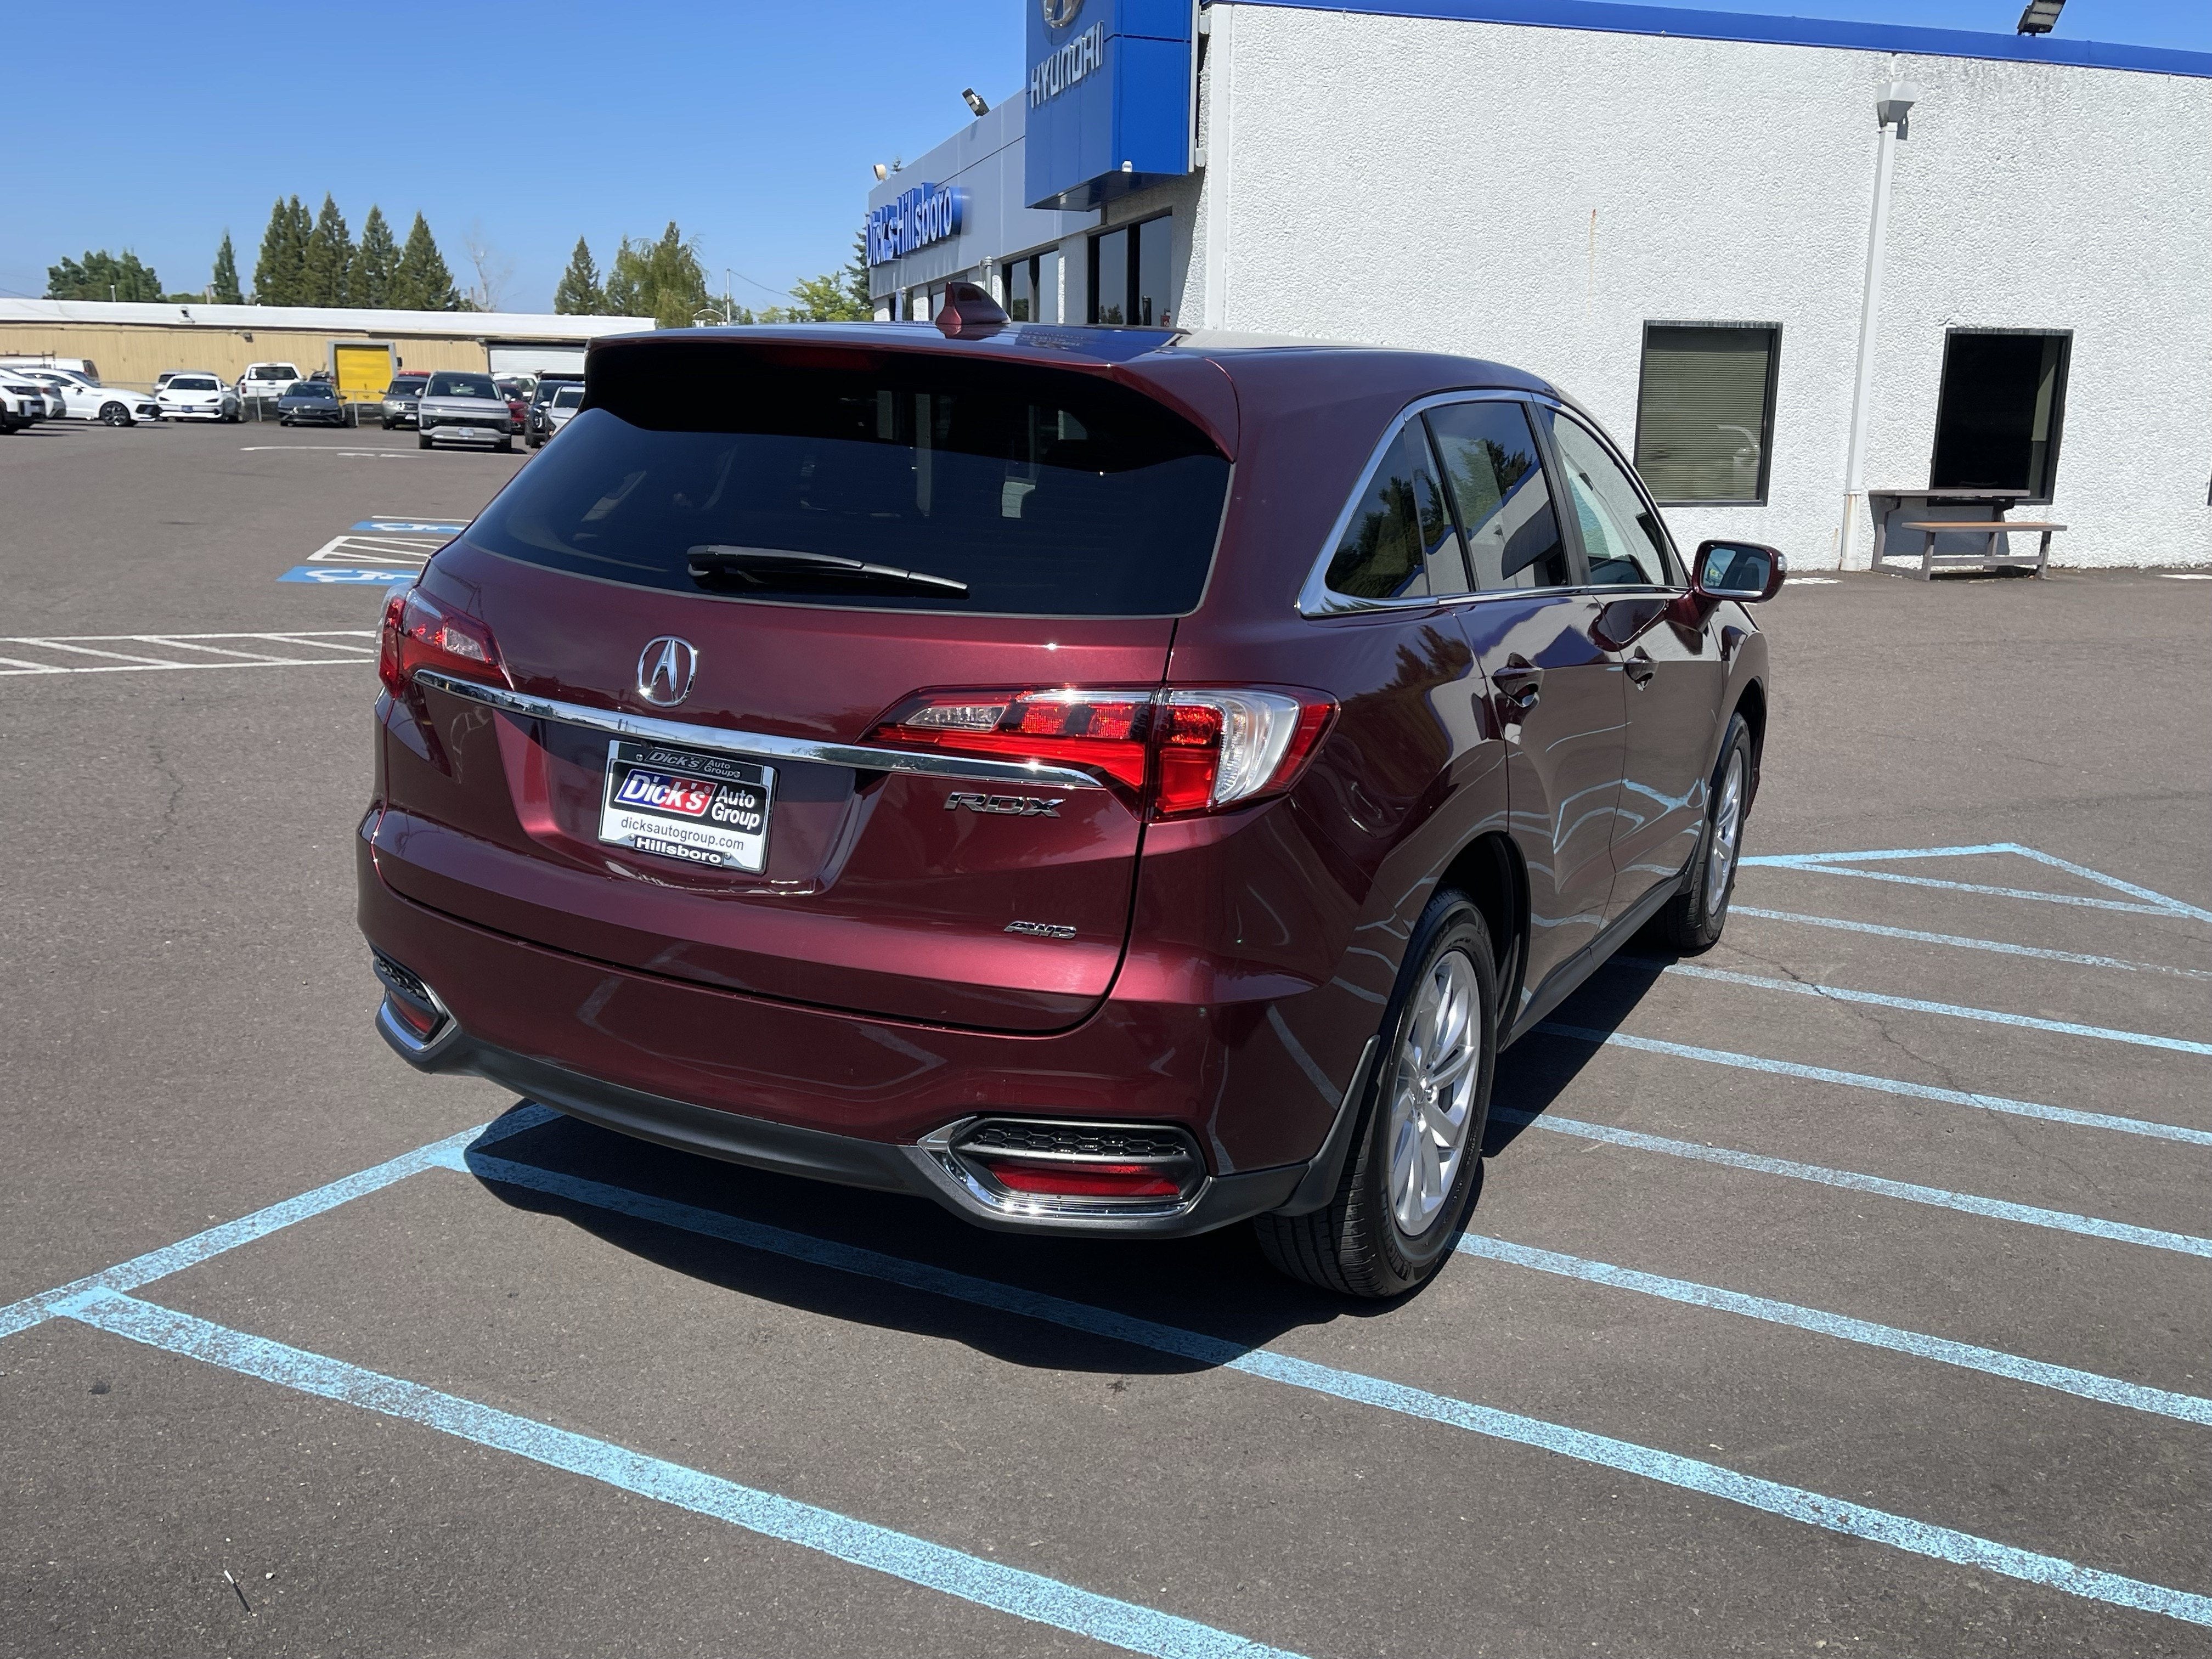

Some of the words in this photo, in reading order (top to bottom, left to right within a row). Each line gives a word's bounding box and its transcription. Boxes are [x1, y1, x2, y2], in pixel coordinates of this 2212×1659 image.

[1031, 20, 1104, 109] HYUNDAI
[866, 206, 895, 268] Dick's
[897, 183, 952, 255] Hillsboro
[649, 751, 700, 768] Dick's
[707, 759, 731, 769] Auto
[703, 765, 735, 777] Group
[622, 774, 706, 811] Dick's
[715, 785, 755, 809] Auto
[944, 792, 1066, 818] RDX
[711, 803, 761, 831] Group
[621, 816, 744, 851] dicksautogroup.com
[636, 836, 722, 864] Hillsboro
[1003, 921, 1077, 940] AWD
